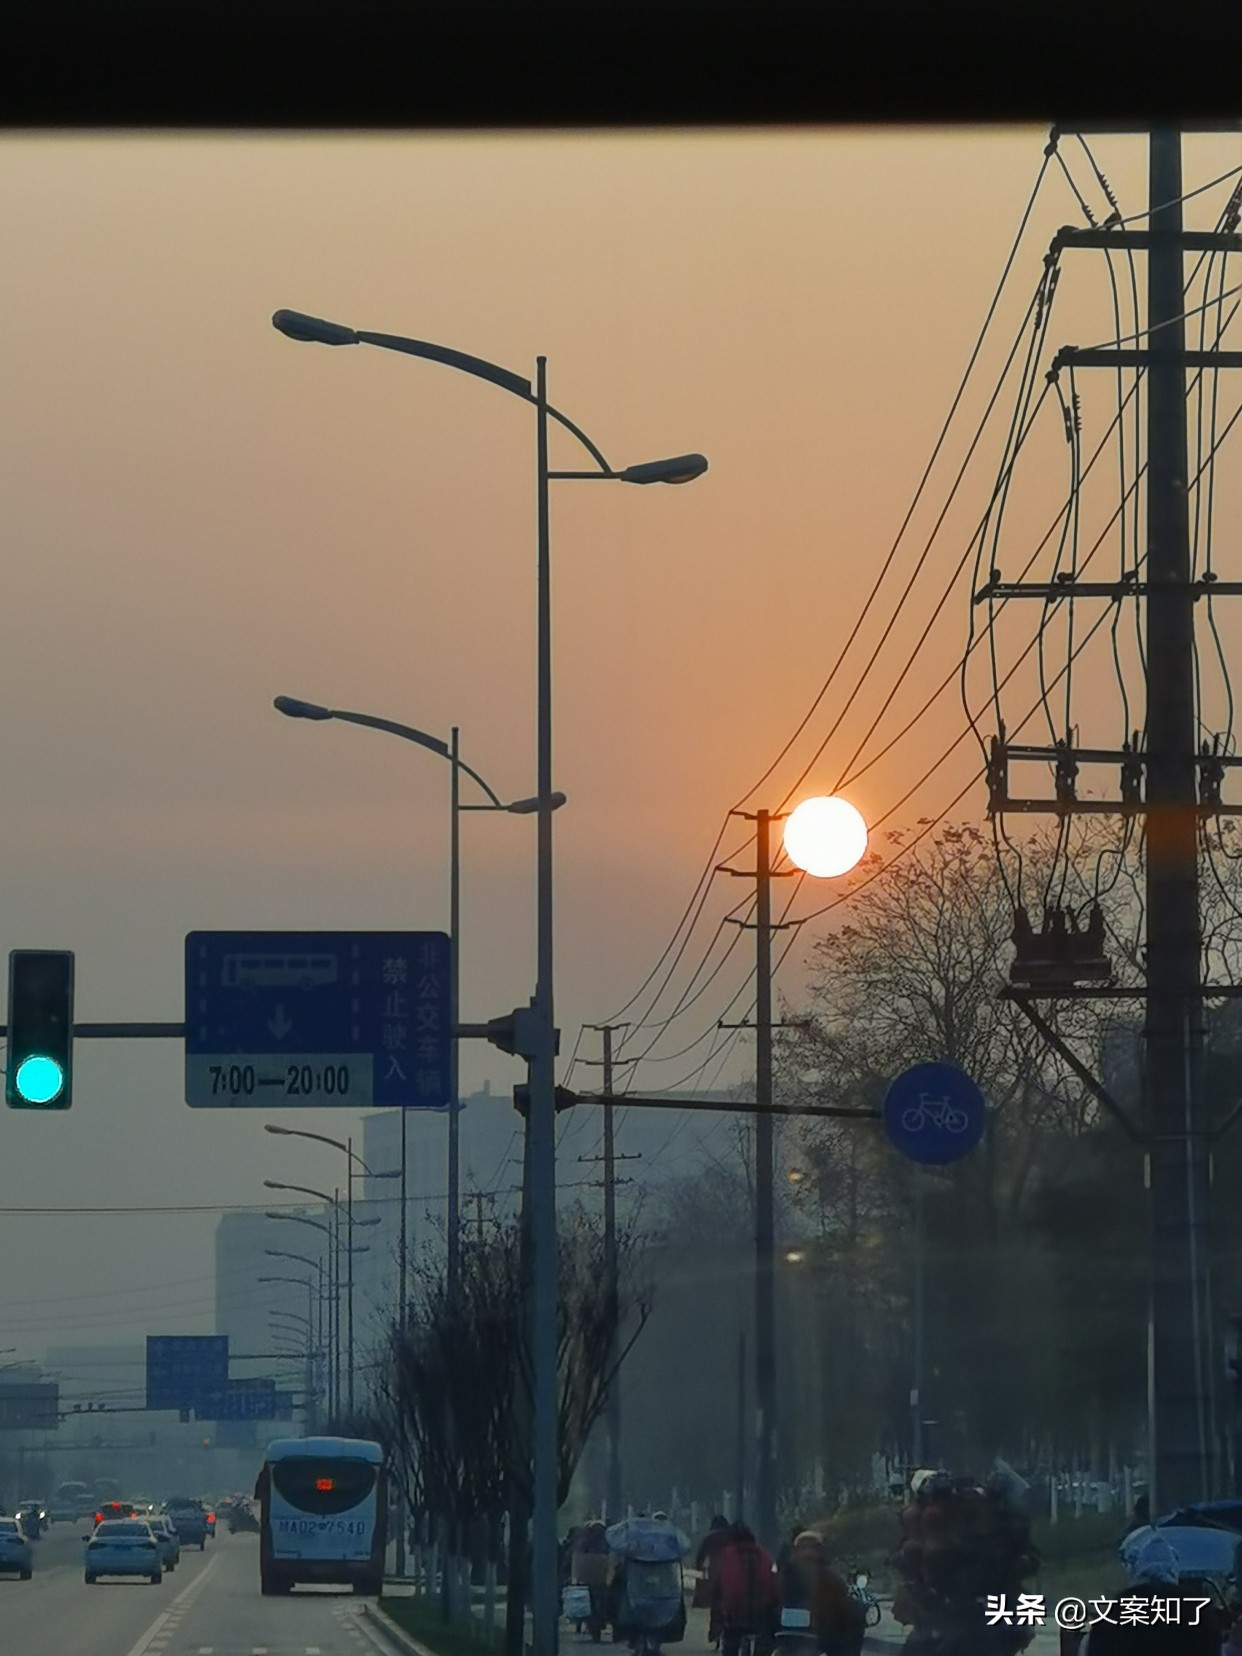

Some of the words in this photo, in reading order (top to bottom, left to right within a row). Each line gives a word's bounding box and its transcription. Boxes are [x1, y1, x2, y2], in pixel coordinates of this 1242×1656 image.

[382, 957, 408, 1080] 禁止驶入
[416, 942, 441, 1096] 非公交车辆
